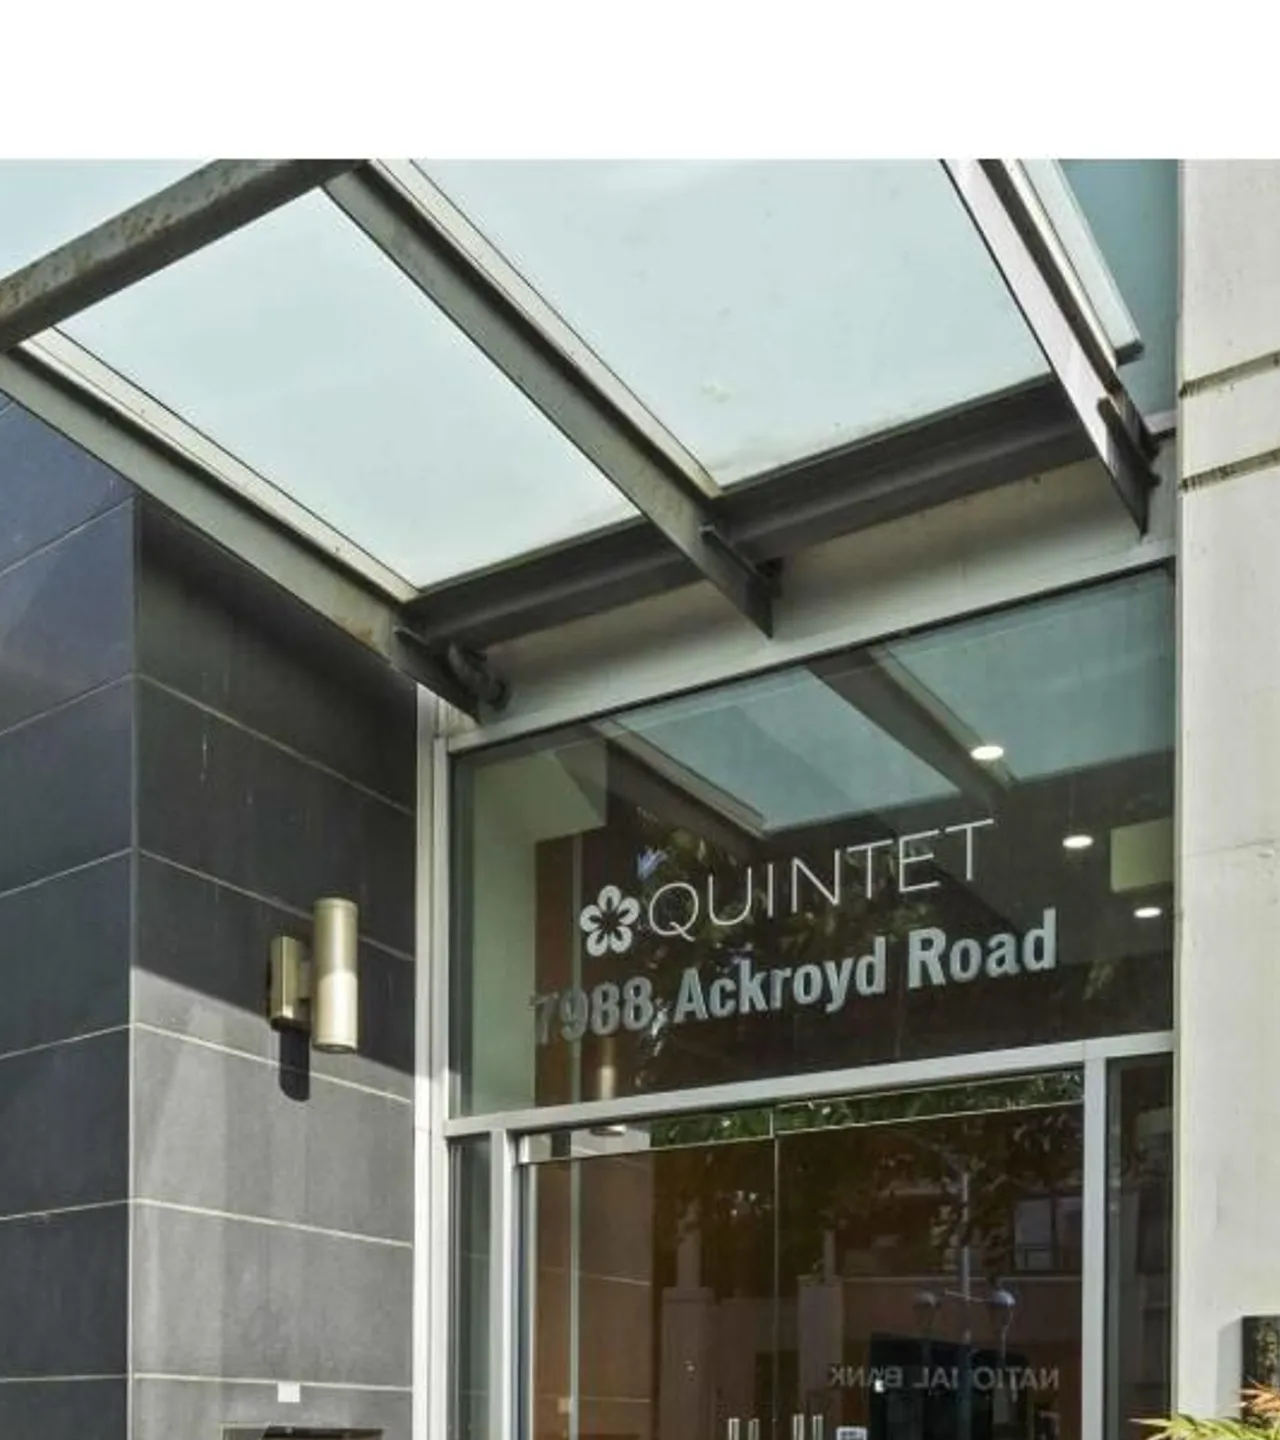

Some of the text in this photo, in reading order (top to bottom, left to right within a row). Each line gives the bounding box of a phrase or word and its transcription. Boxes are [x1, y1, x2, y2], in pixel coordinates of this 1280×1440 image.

[648, 817, 996, 943] QUINTET
[675, 936, 887, 1029] Ackroyd
[907, 908, 1058, 990] Road
